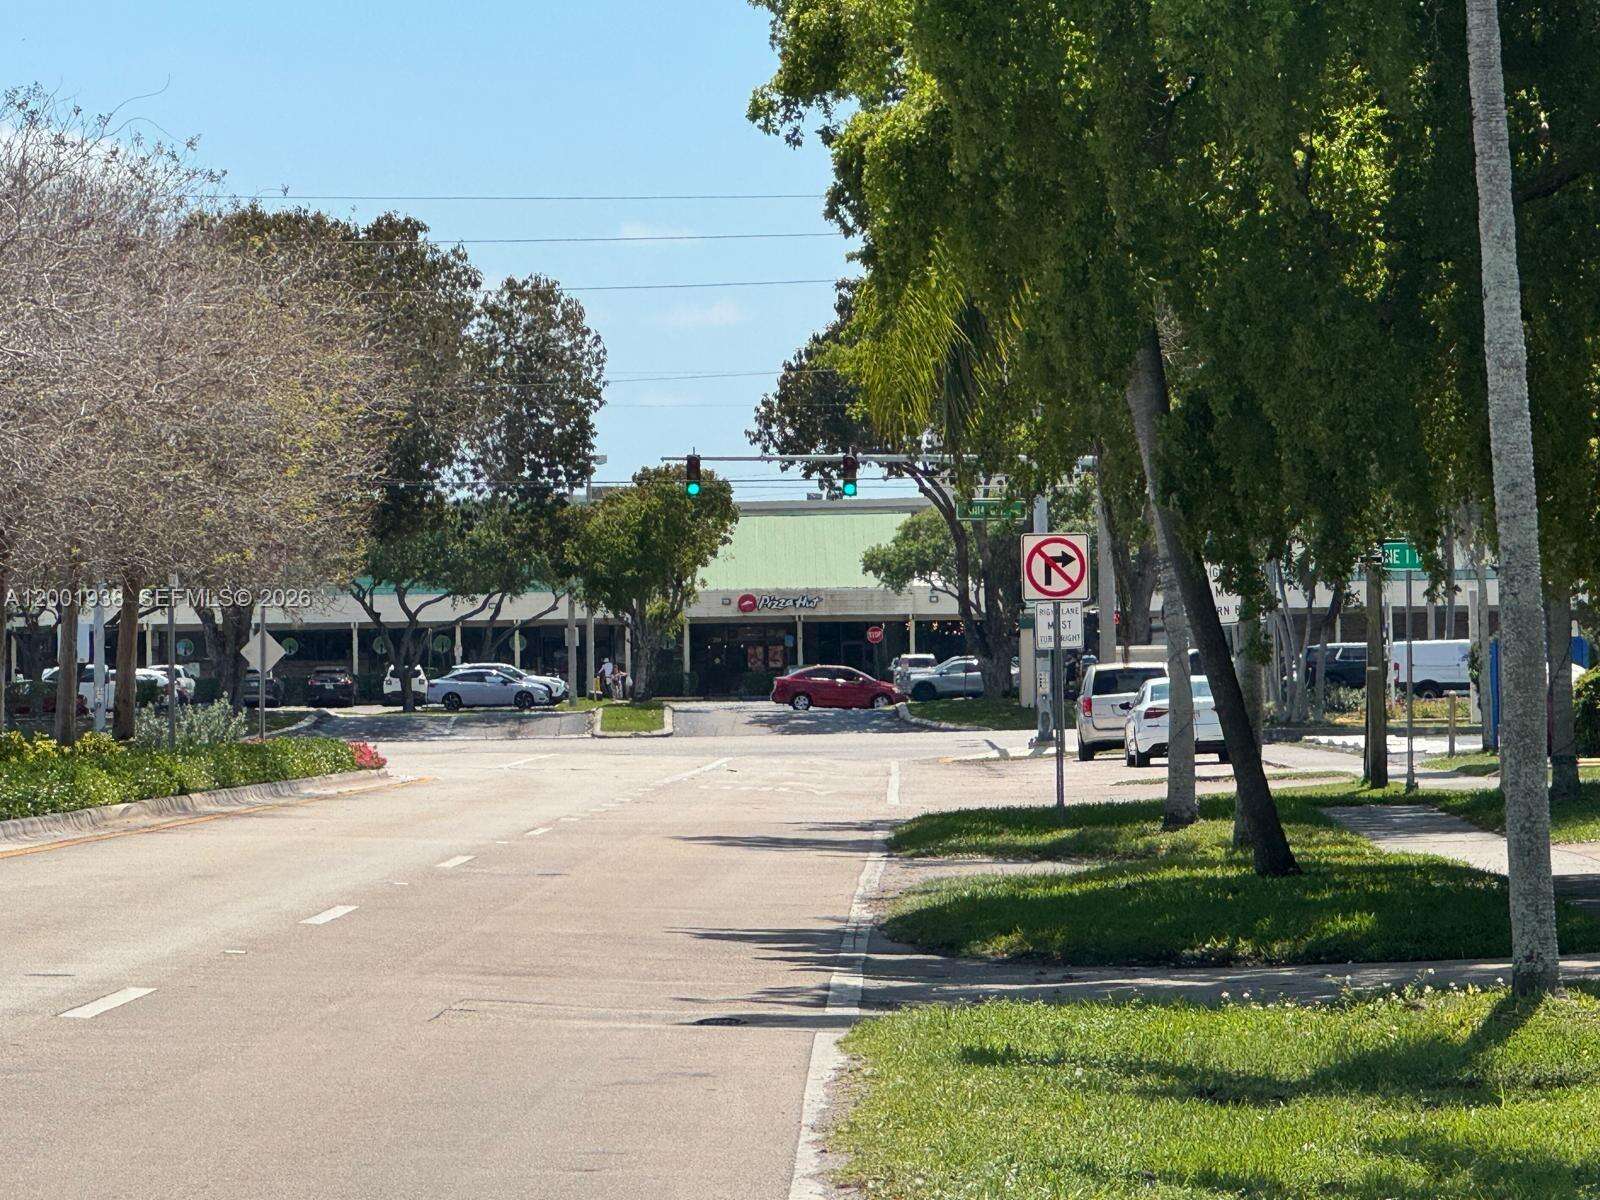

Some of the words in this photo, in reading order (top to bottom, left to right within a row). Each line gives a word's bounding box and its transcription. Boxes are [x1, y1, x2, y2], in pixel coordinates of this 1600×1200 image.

[1384, 549, 1400, 564] NE
[758, 594, 795, 610] Pizza
[794, 593, 823, 609] Hut
[1061, 607, 1079, 615] LANE
[1047, 620, 1071, 630] MST
[868, 631, 882, 639] STOP
[1039, 635, 1053, 643] TUR
